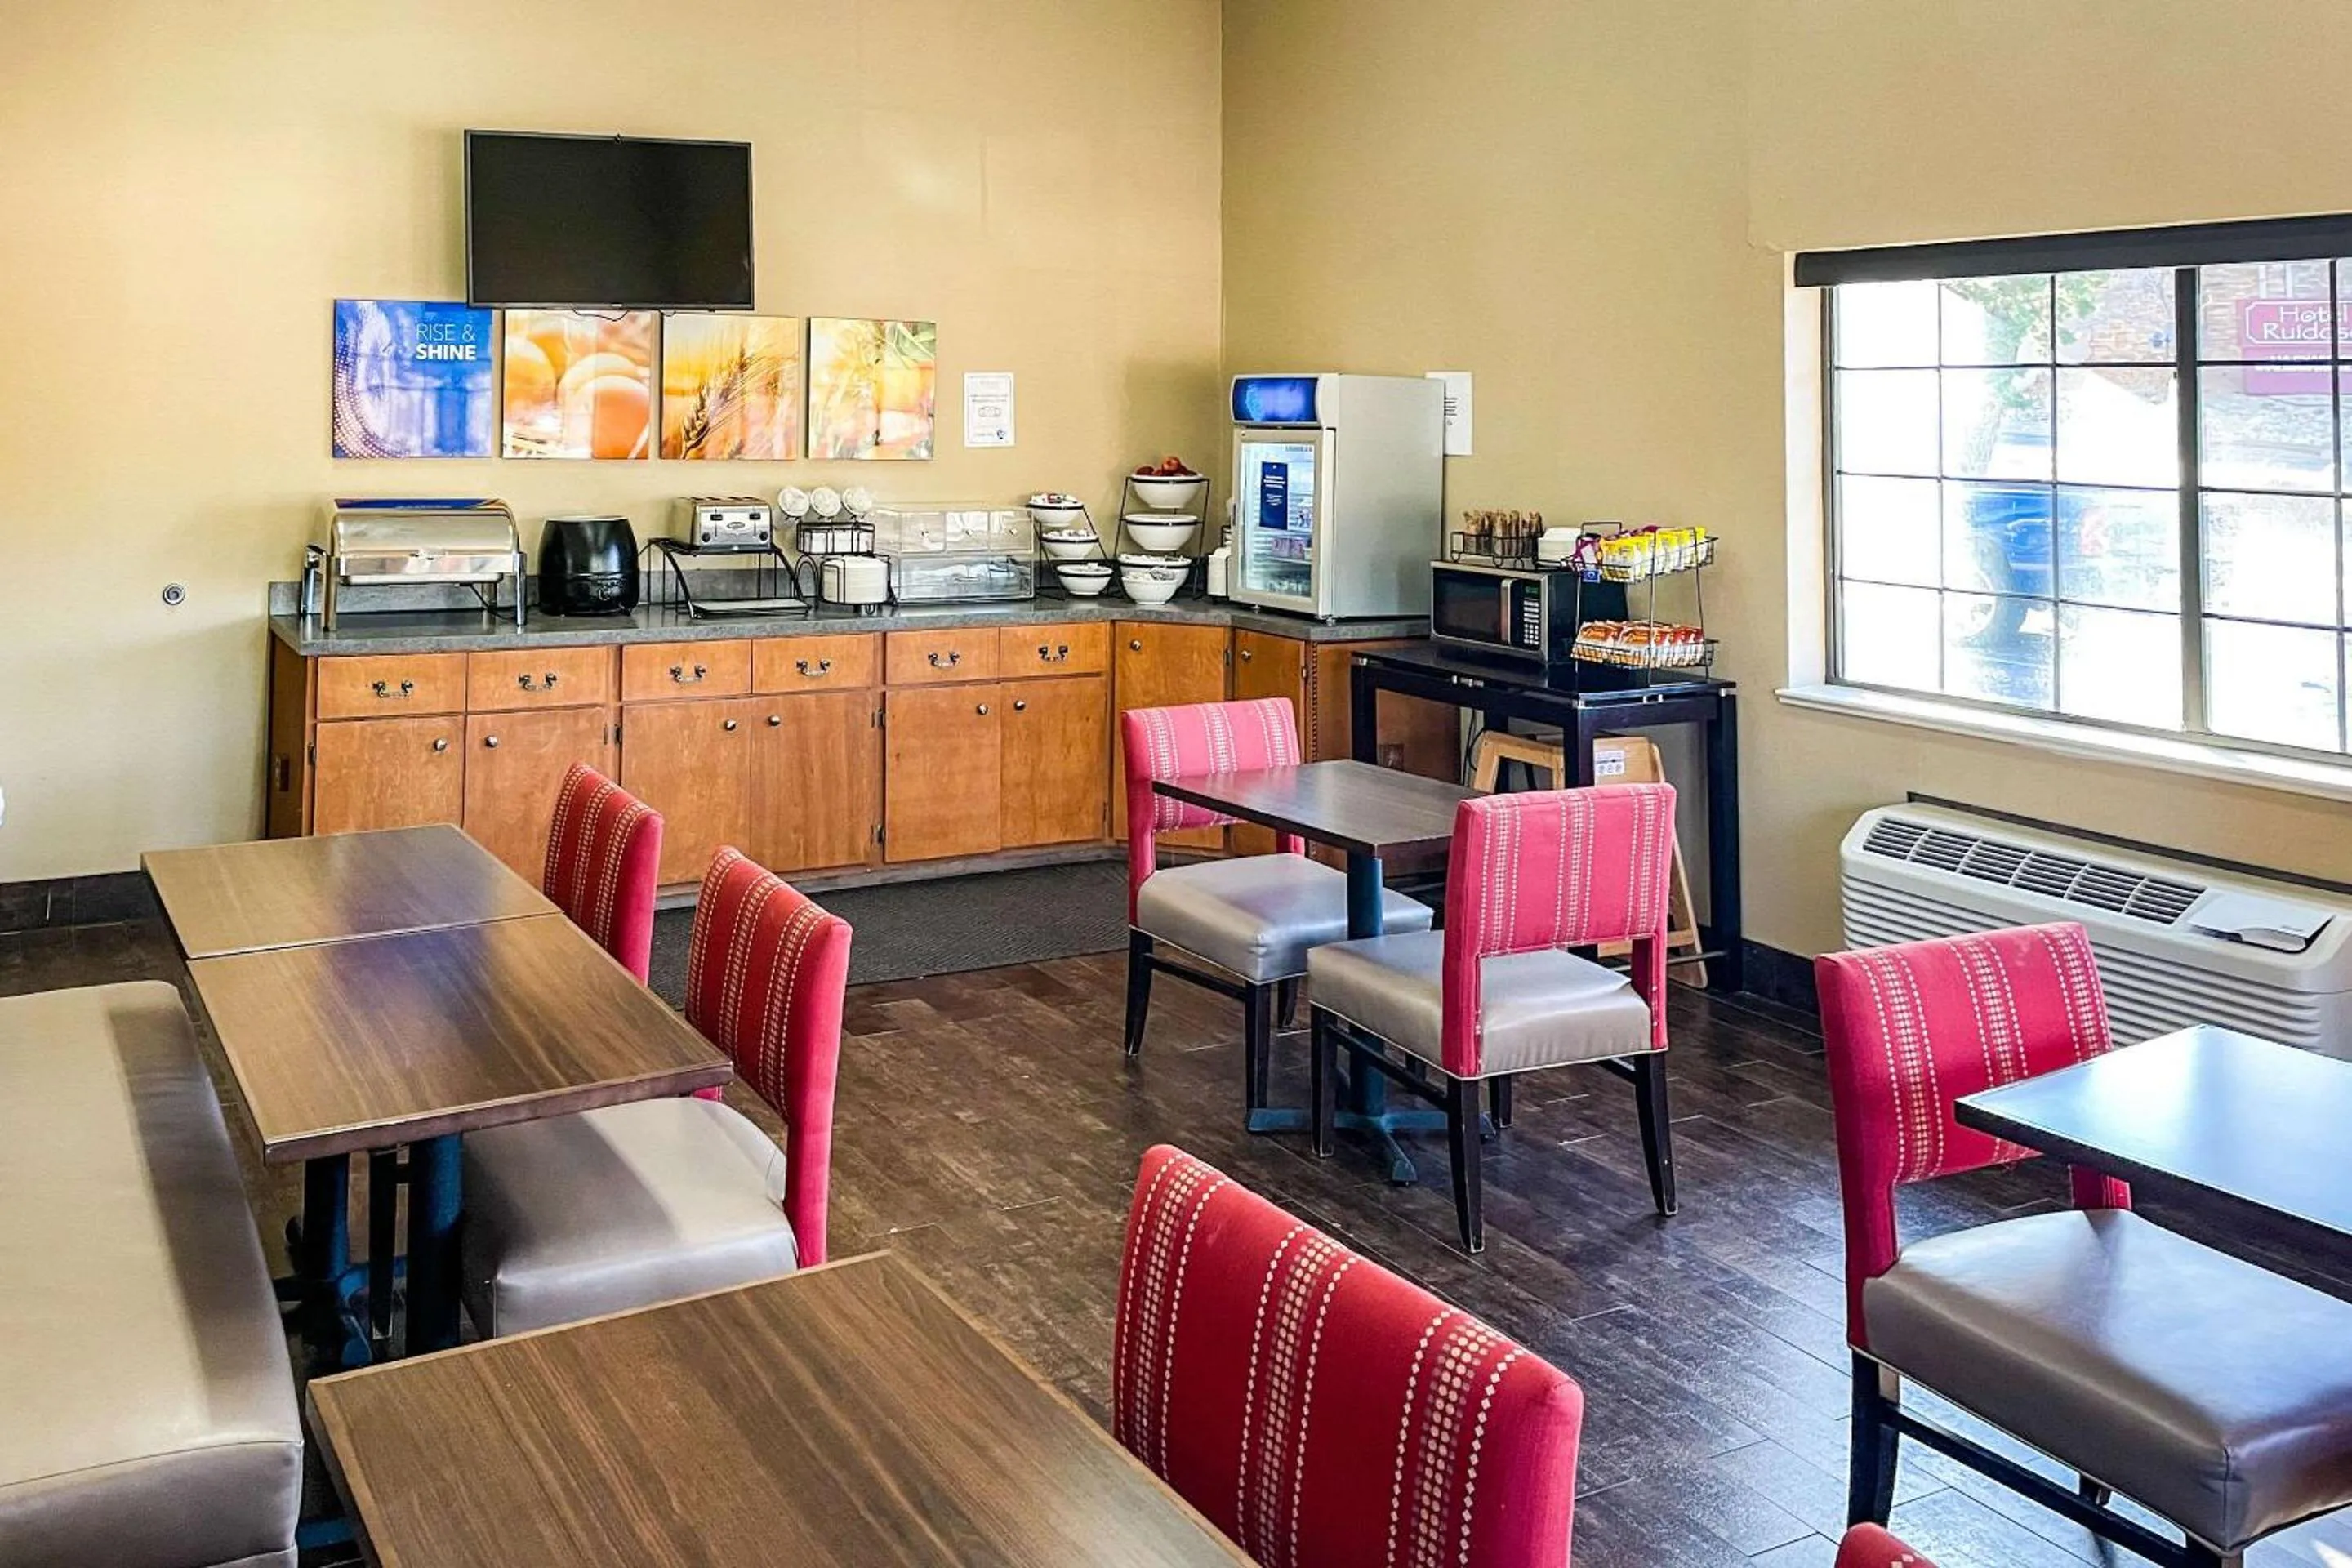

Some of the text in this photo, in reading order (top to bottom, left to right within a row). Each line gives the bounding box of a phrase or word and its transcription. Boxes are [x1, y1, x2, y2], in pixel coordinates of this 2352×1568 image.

[416, 323, 475, 342] RISE &
[2262, 321, 2352, 340] Ruidos
[416, 343, 477, 360] SHINE
